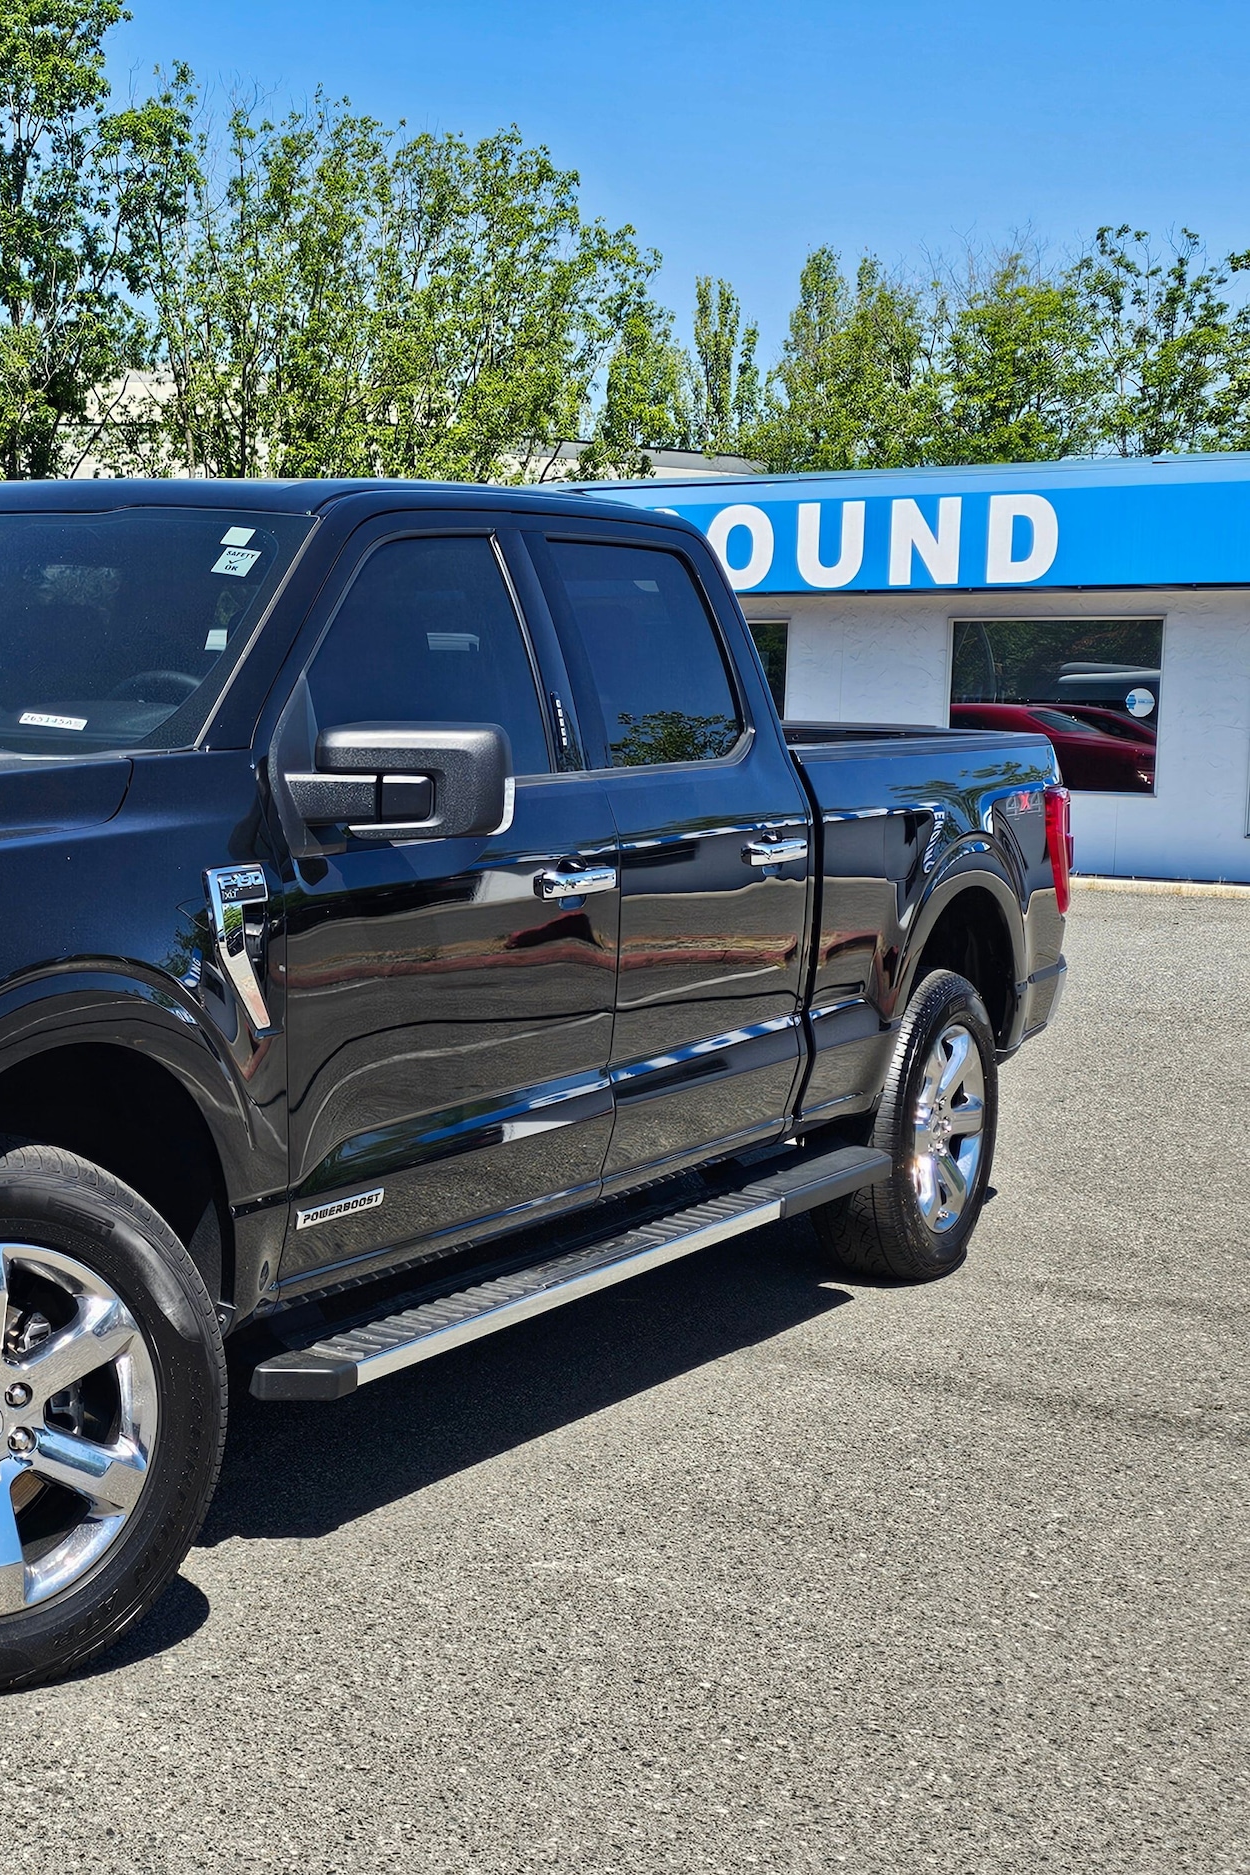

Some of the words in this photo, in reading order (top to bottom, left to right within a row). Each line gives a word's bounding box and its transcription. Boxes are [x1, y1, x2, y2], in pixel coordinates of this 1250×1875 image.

[654, 494, 1059, 592] OUND
[226, 550, 256, 559] SAFETY
[224, 564, 239, 572] OK
[302, 1192, 381, 1225] POWERBOOST
